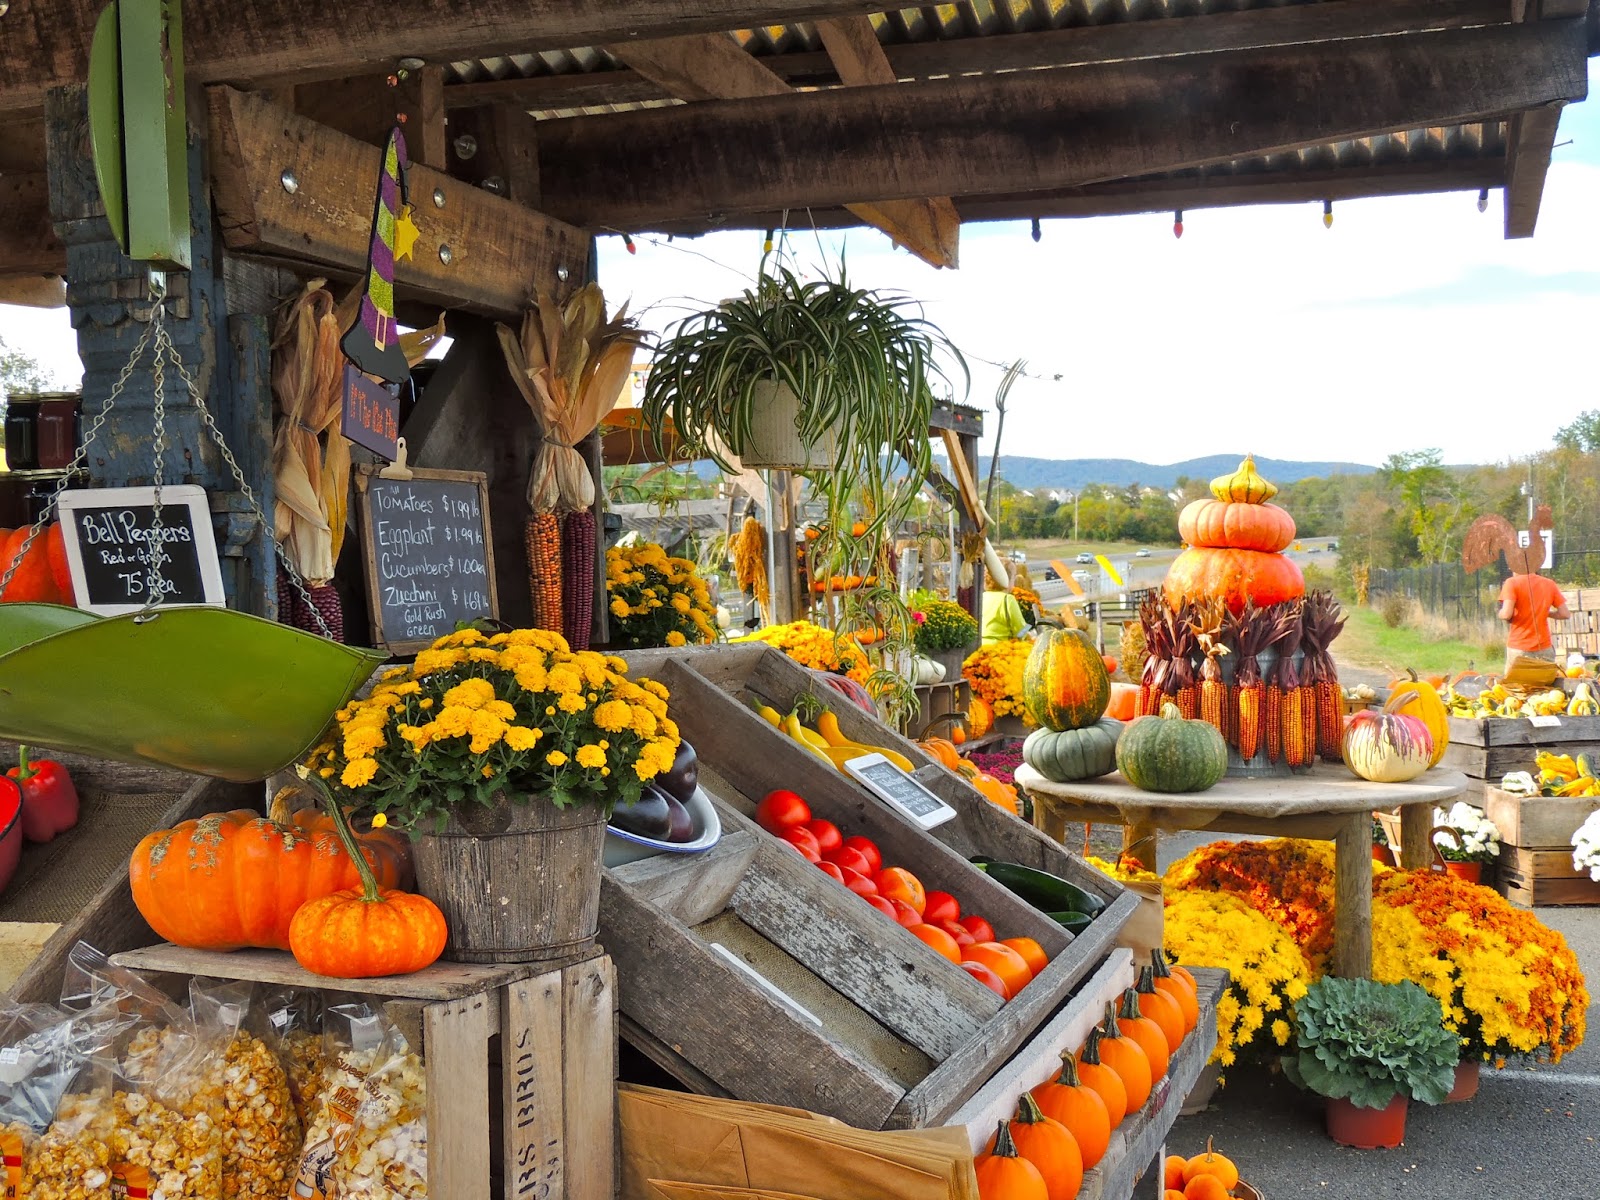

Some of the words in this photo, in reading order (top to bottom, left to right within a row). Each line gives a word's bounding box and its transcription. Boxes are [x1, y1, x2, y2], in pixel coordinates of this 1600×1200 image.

[82, 511, 124, 545] Bell
[378, 517, 436, 558] Eggplant
[100, 547, 126, 565] Red
[127, 555, 136, 563] or
[381, 552, 450, 578] Cucumbers
[384, 580, 438, 607] Zucchini
[404, 606, 422, 624] Gold
[424, 605, 447, 621] Rush
